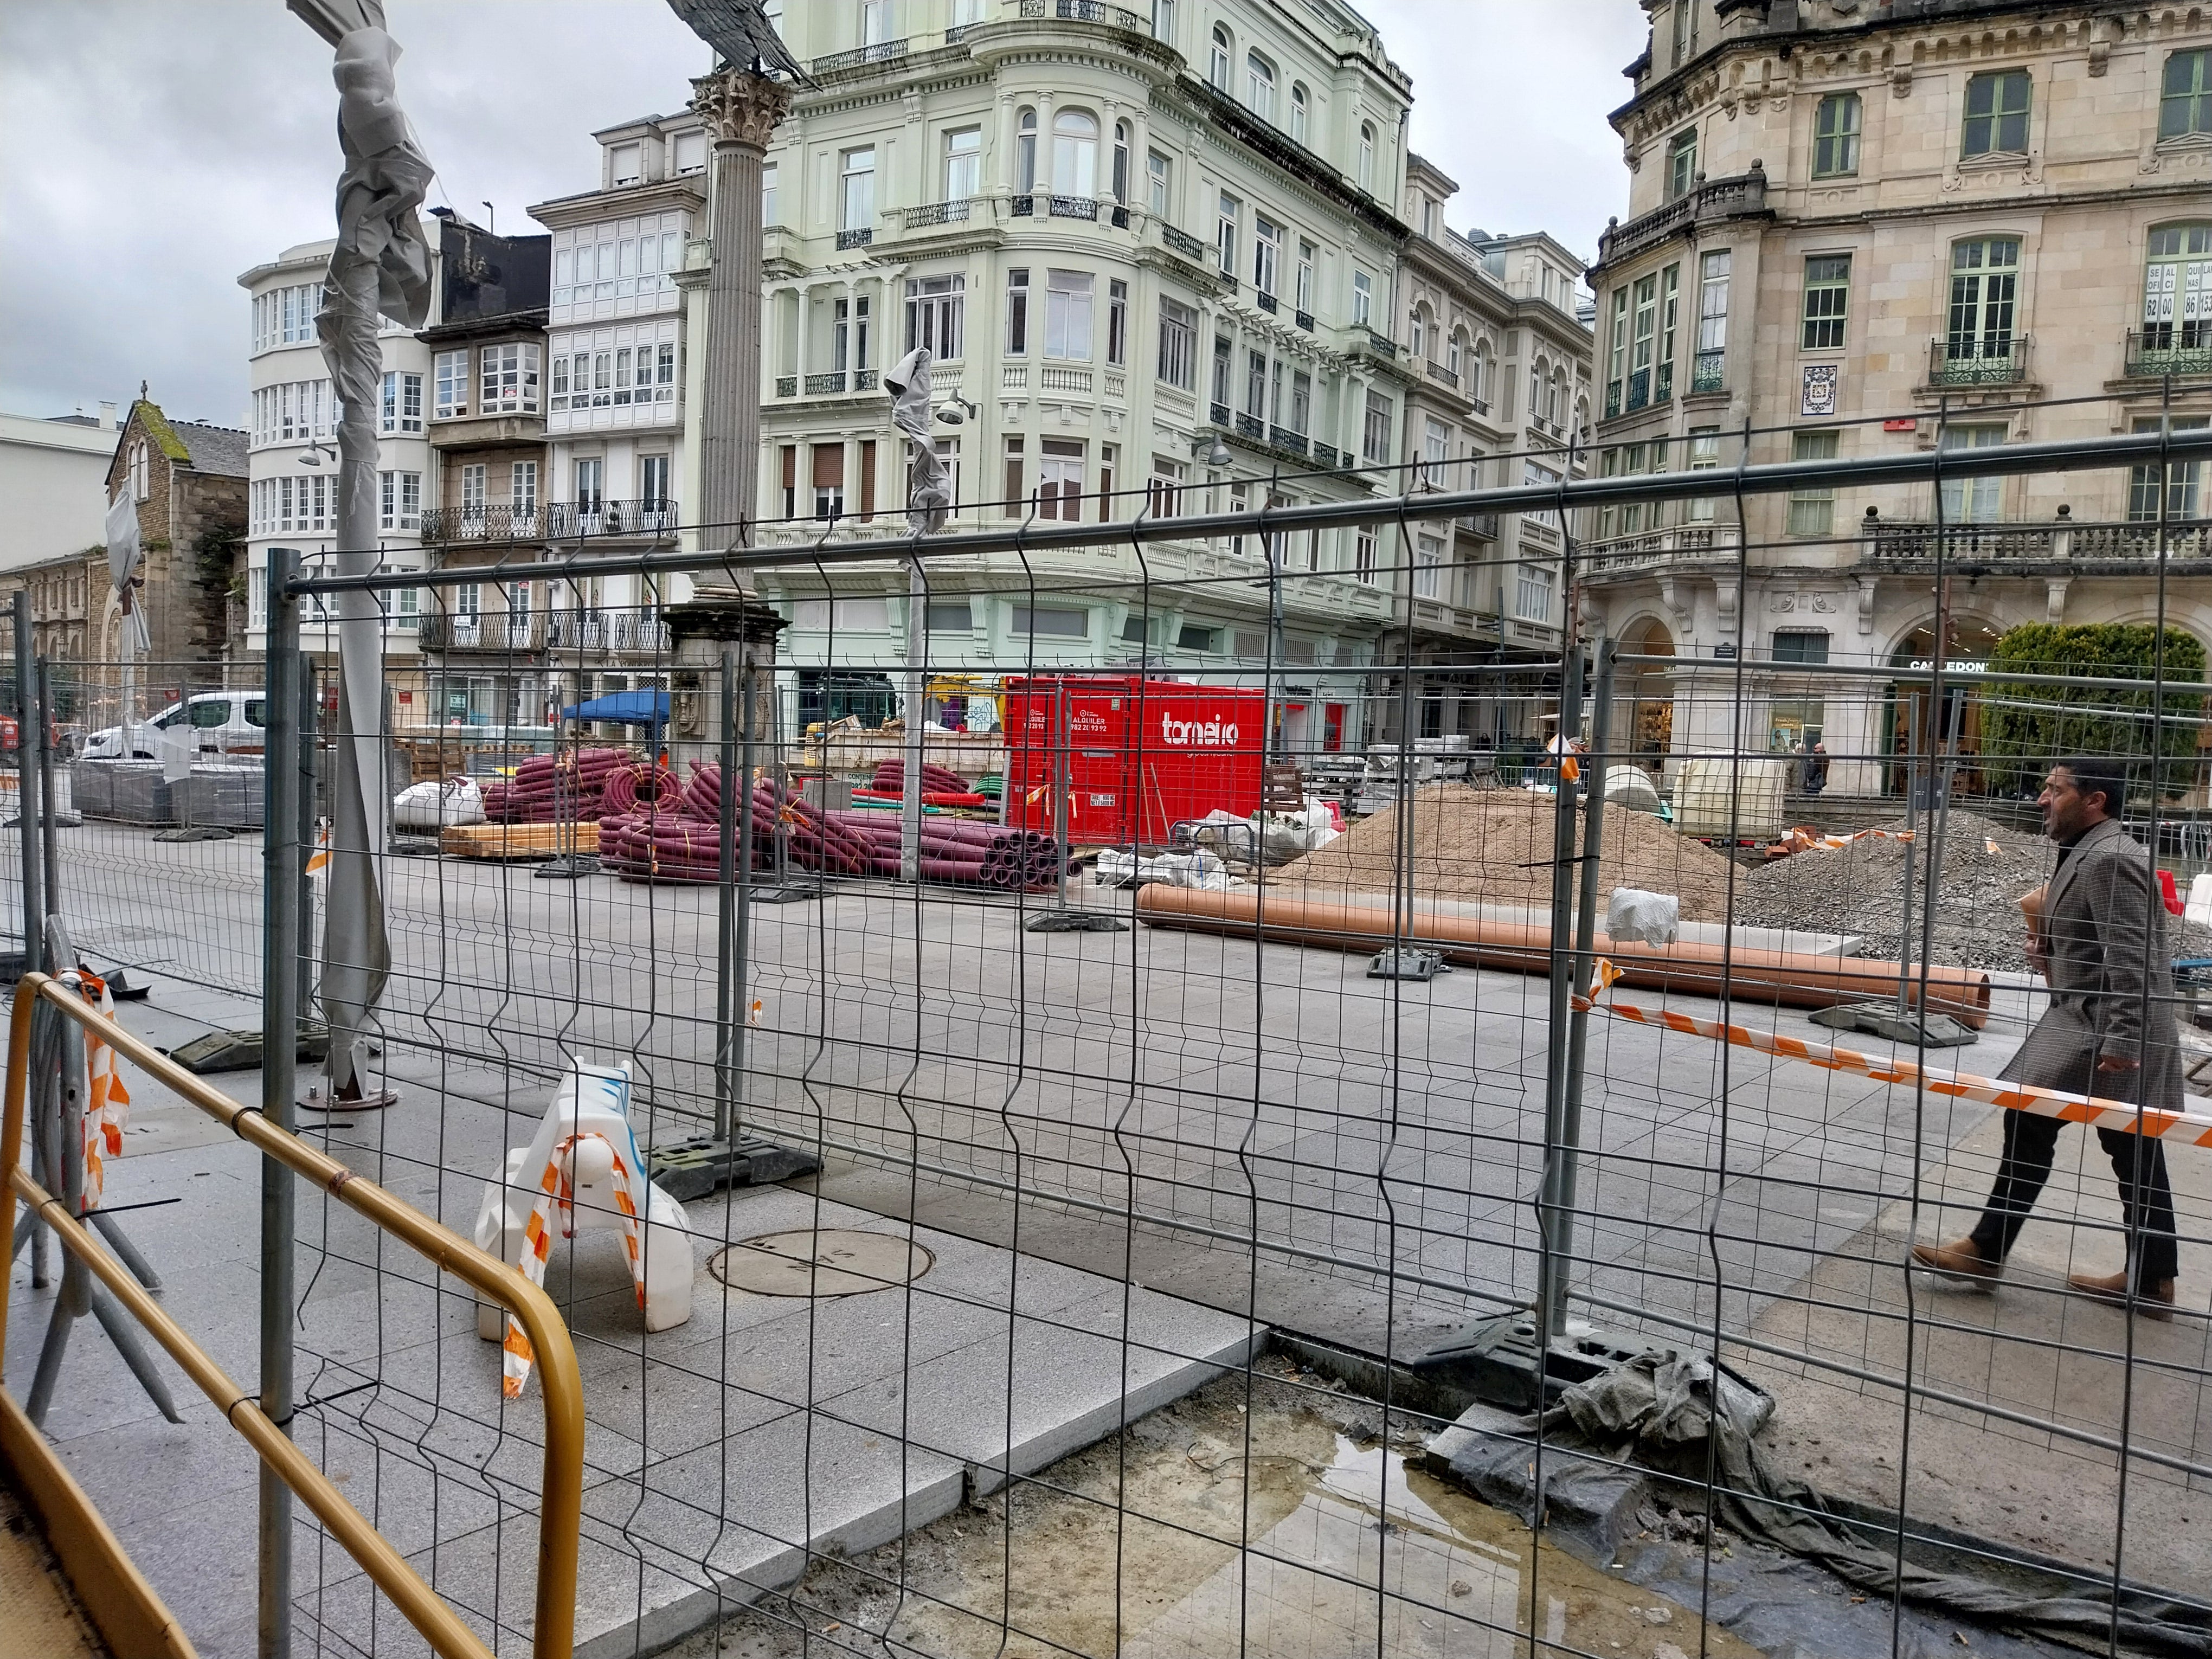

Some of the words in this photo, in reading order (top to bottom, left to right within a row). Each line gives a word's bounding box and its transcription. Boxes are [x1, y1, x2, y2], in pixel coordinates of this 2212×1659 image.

[2150, 269, 2159, 278] SE
[2148, 281, 2159, 290] OFI
[2147, 300, 2157, 316] 62
[2163, 298, 2172, 315] 00
[2185, 296, 2195, 313] 86
[1072, 717, 1105, 725] ALQUILER
